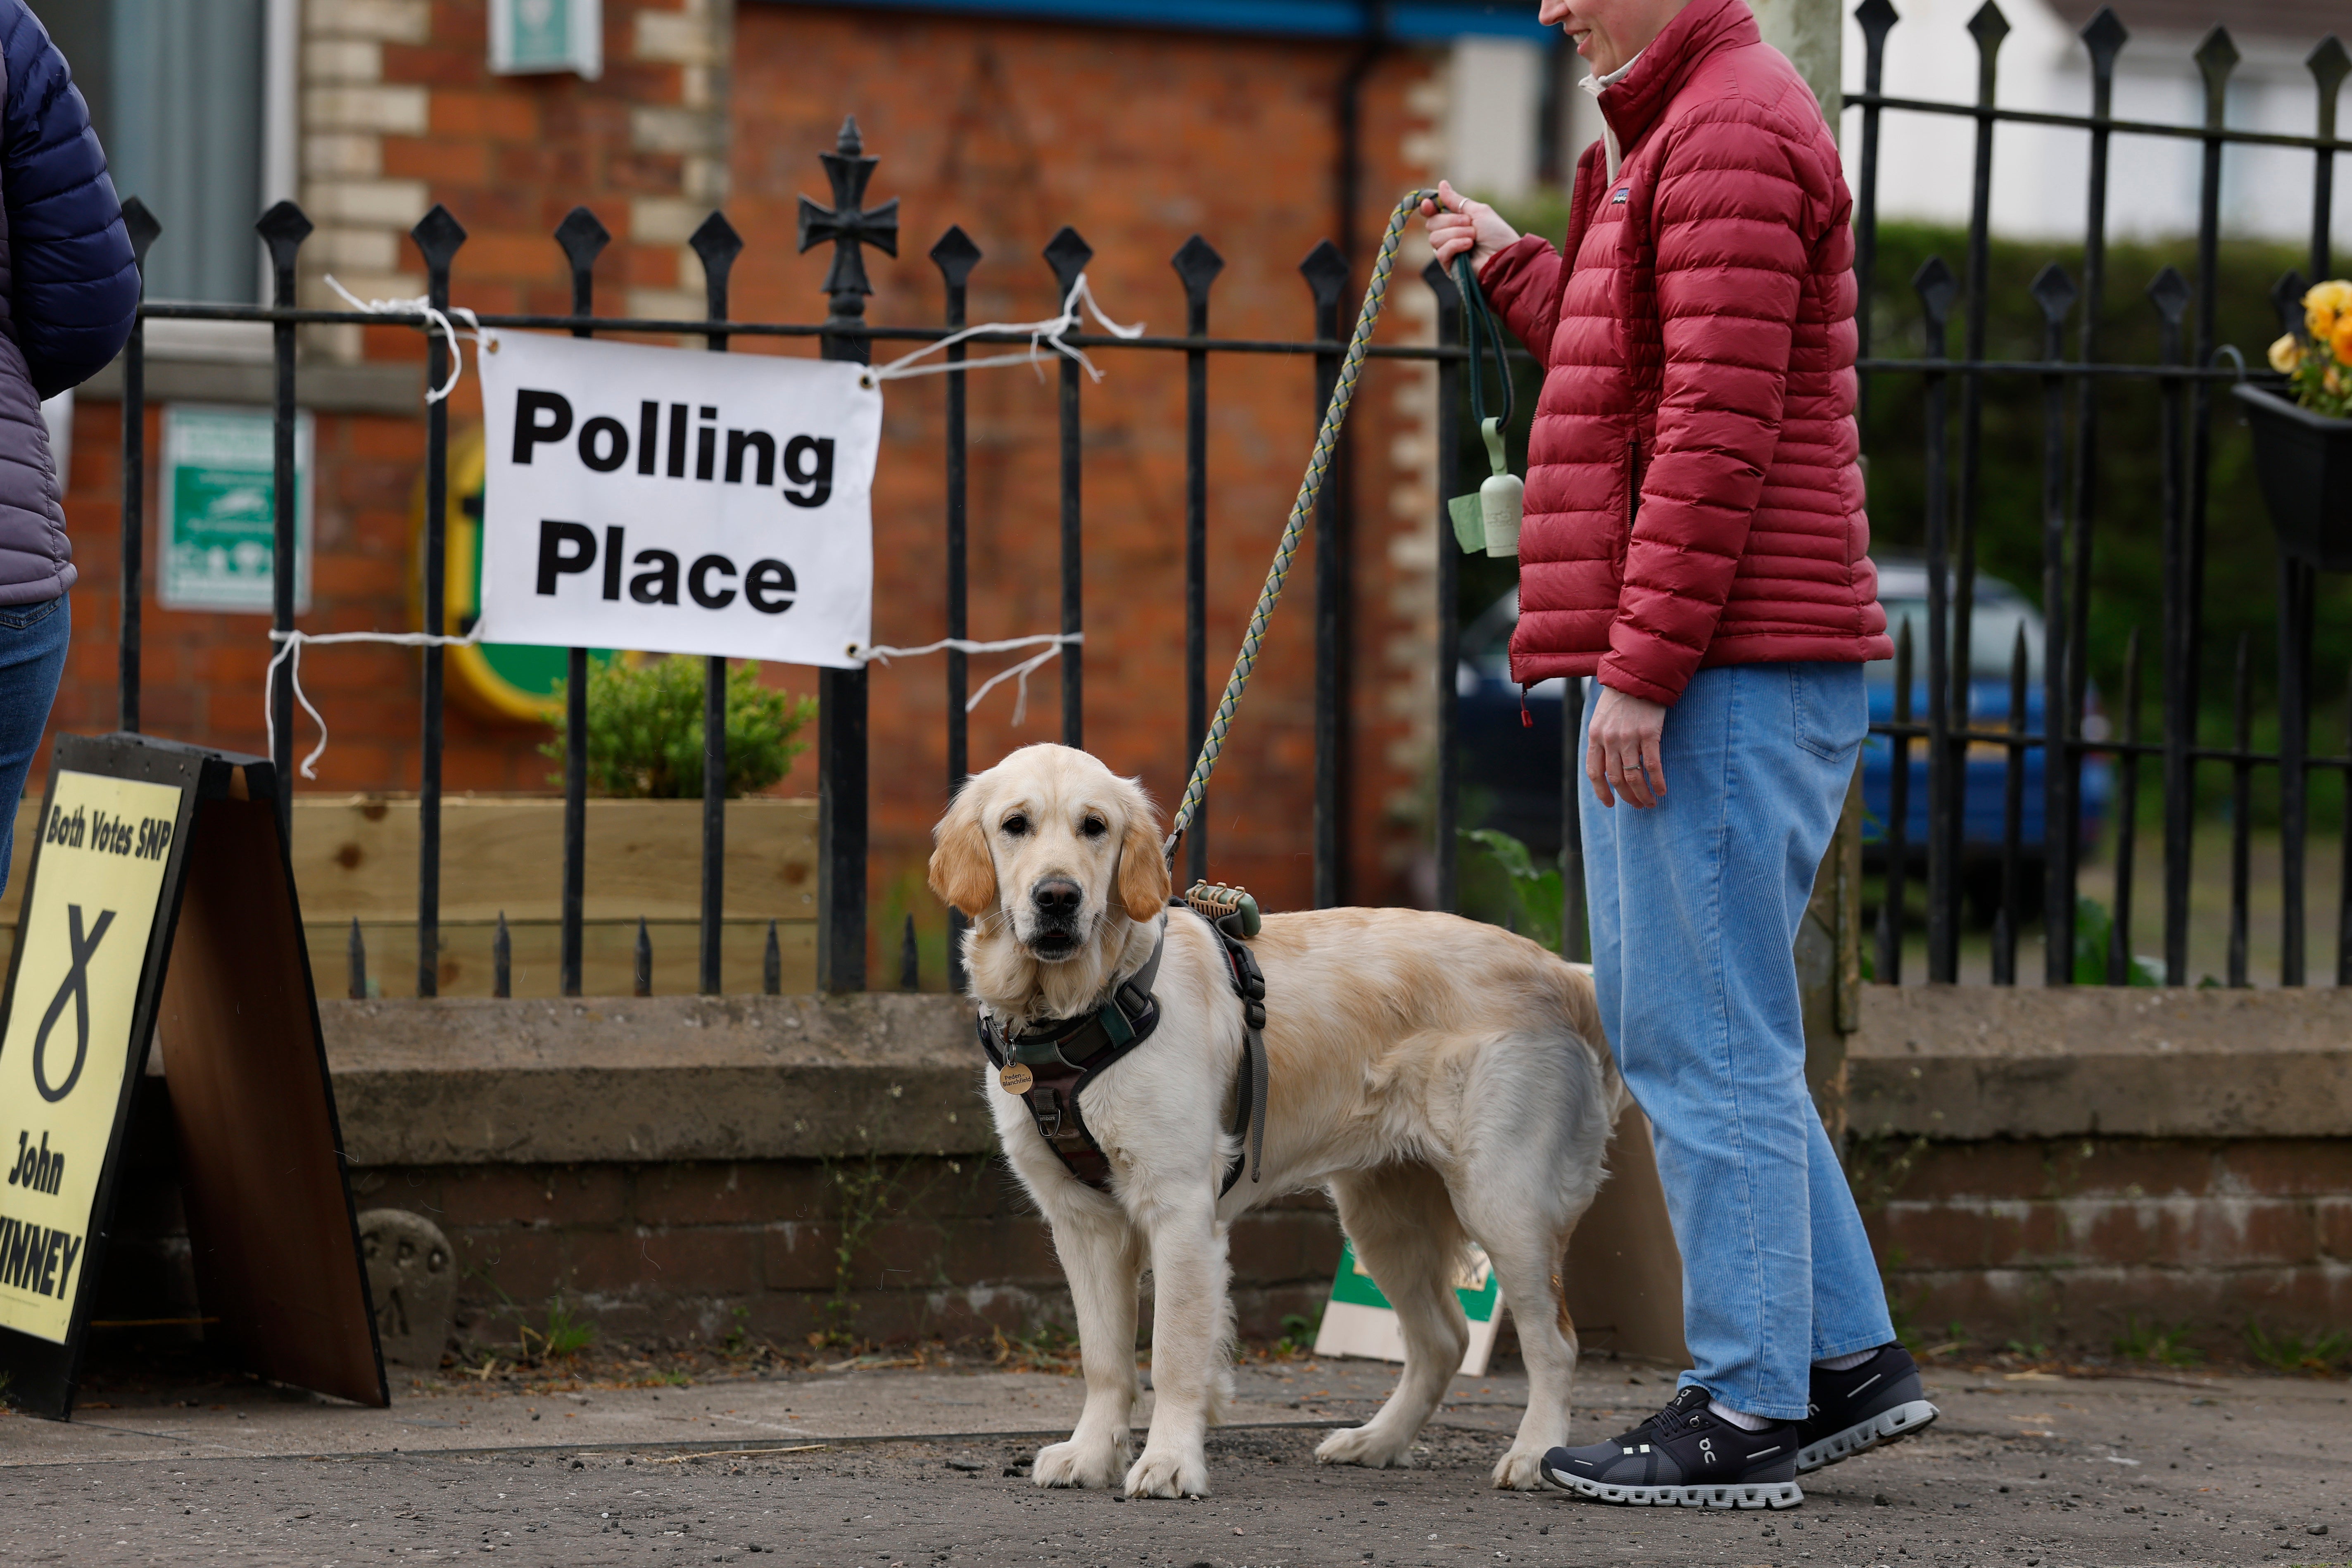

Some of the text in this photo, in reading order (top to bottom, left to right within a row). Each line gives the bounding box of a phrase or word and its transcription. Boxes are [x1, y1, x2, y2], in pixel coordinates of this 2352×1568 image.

[512, 388, 835, 508] Polling
[536, 520, 796, 614] Place
[46, 804, 171, 860] Both Votes SNP
[1003, 1076, 1031, 1086] Blanchfield
[8, 1130, 65, 1195] John
[0, 1215, 83, 1300] INNEY
